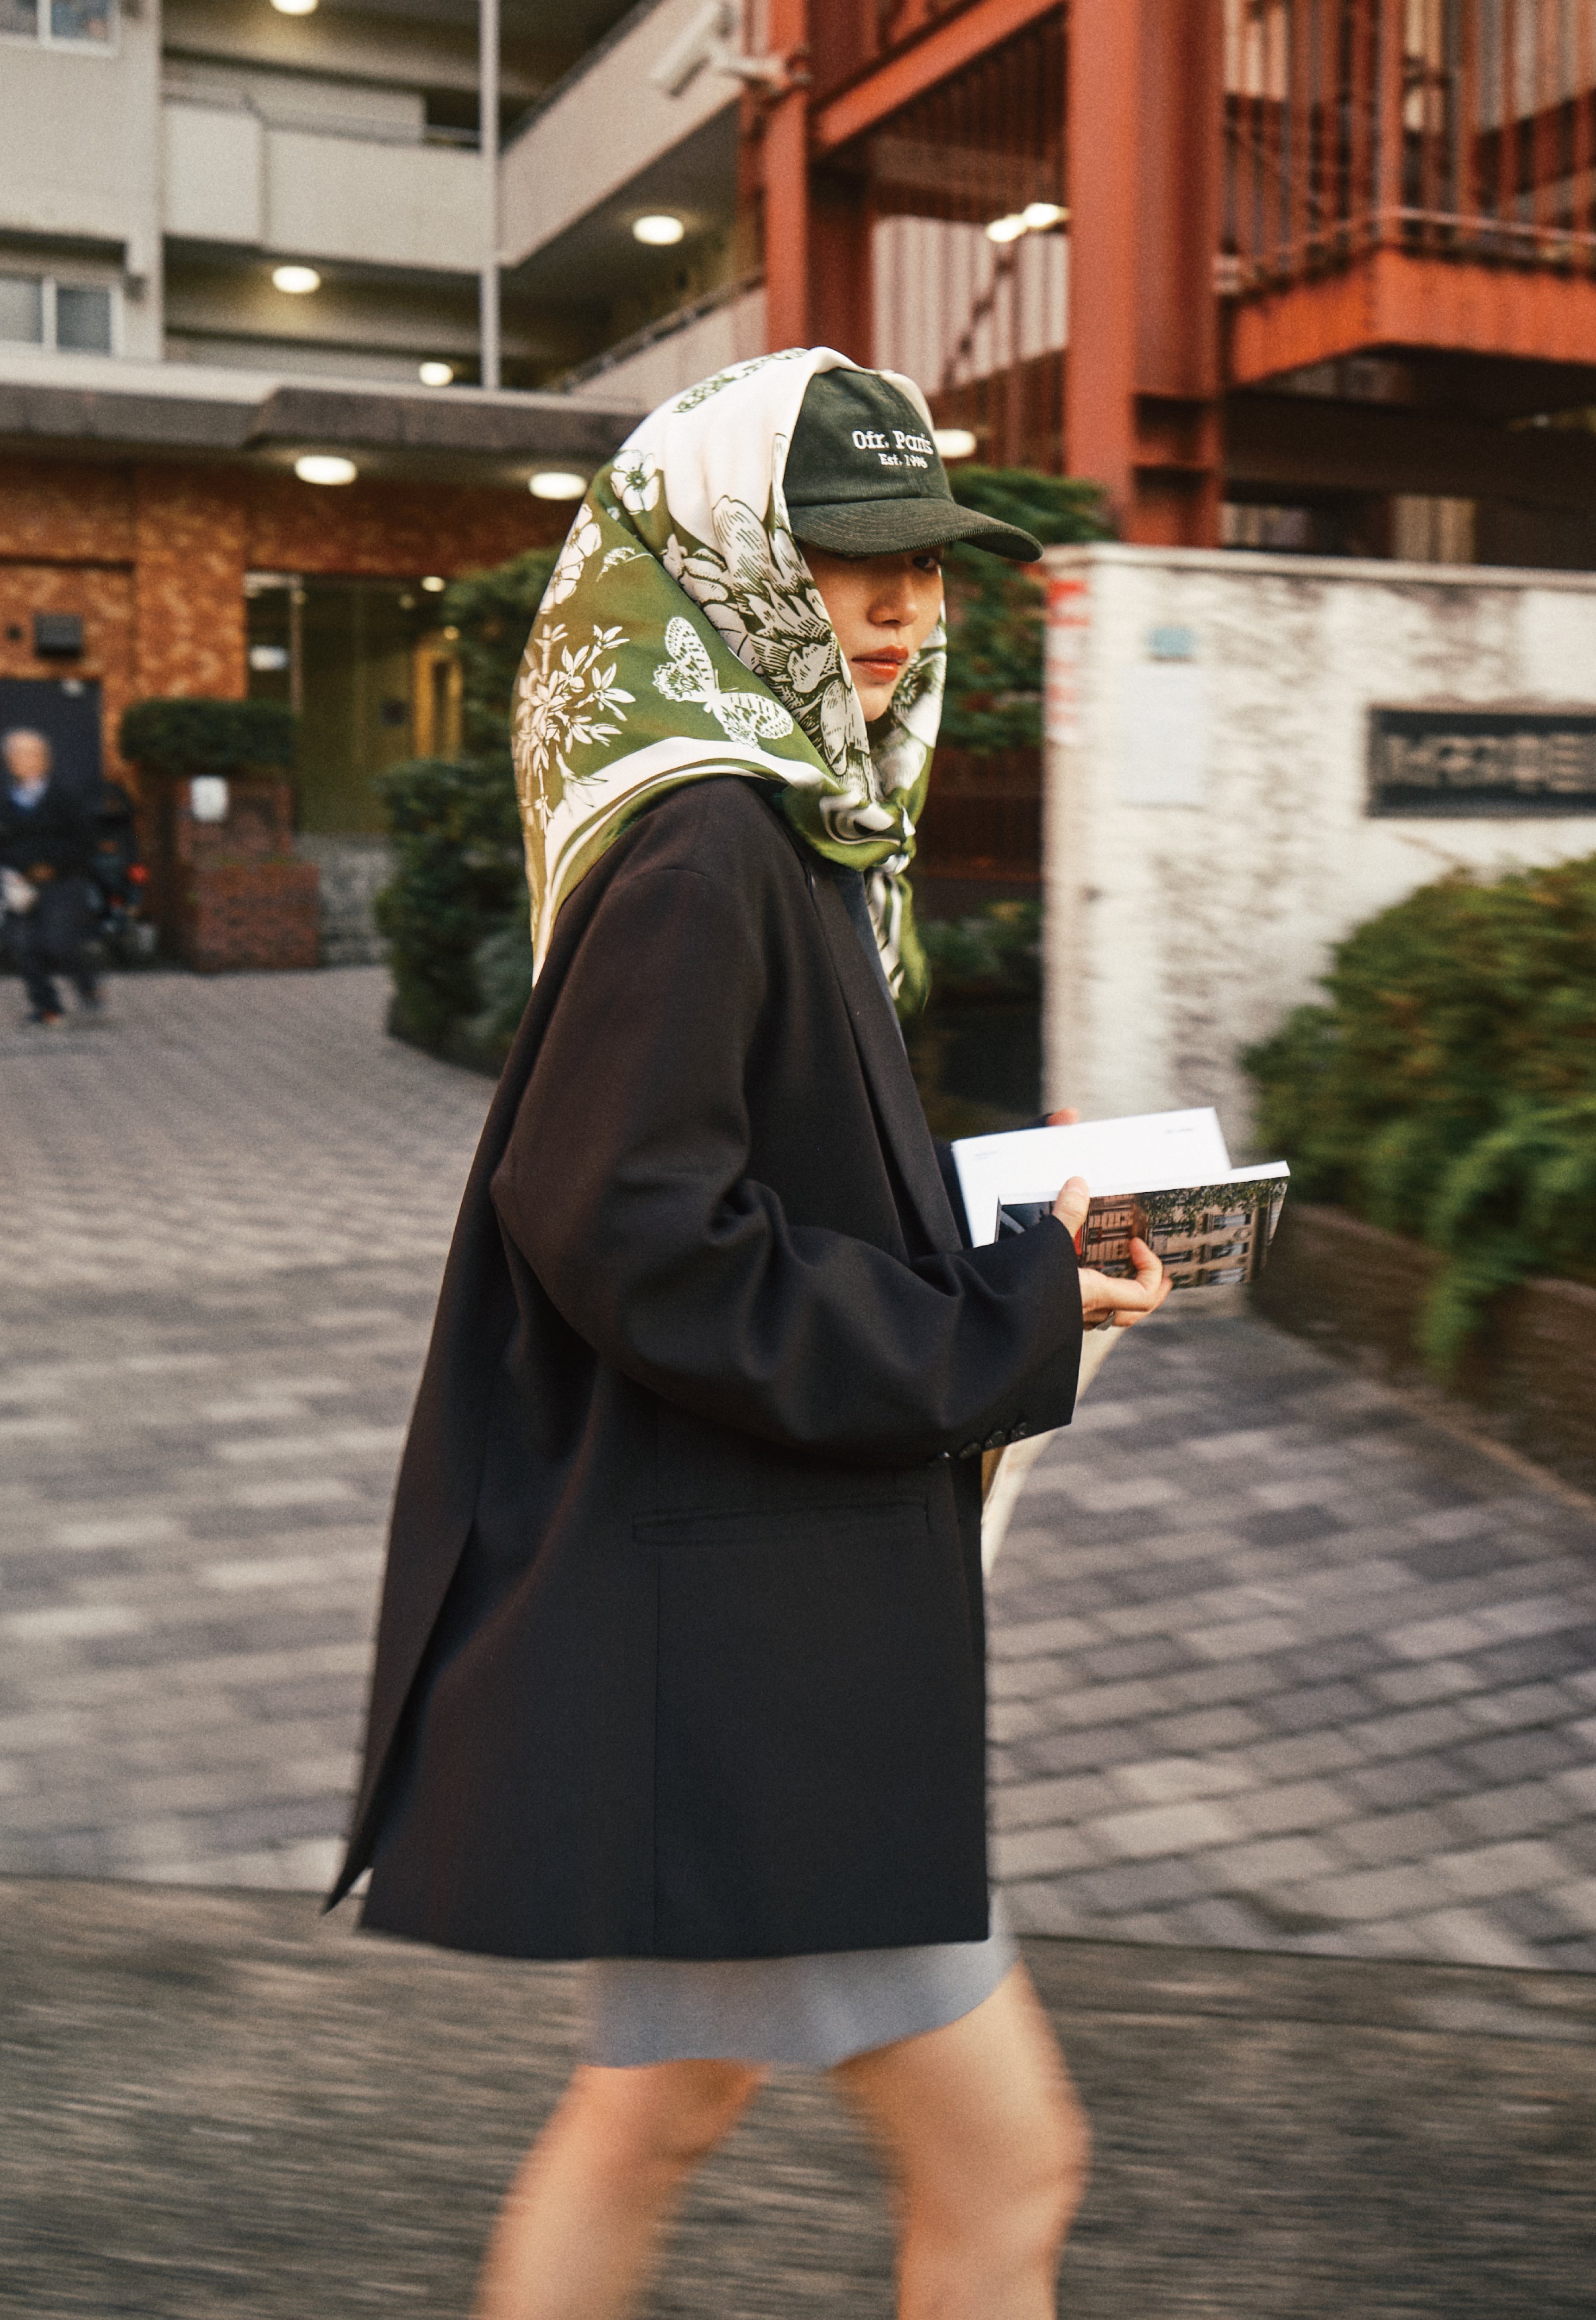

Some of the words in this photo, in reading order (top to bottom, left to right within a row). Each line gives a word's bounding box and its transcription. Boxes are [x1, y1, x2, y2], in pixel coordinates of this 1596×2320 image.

[852, 430, 890, 449] Ofr.
[892, 430, 934, 454] Paris
[878, 453, 902, 466] Est.
